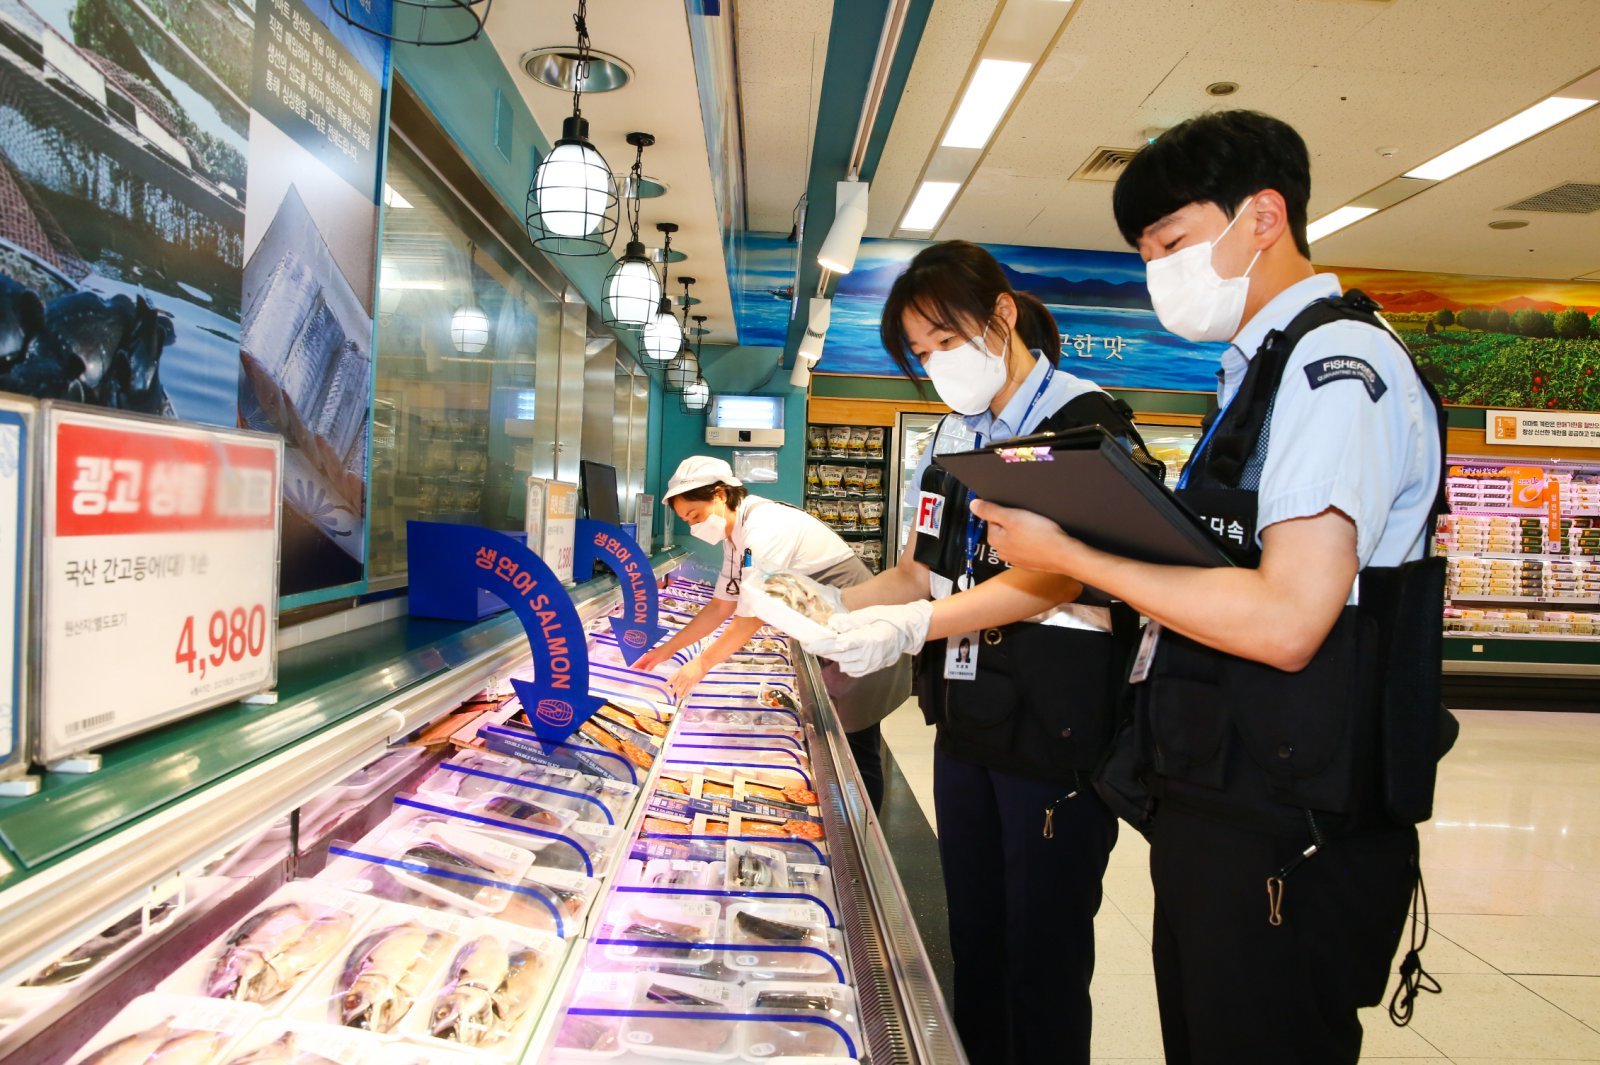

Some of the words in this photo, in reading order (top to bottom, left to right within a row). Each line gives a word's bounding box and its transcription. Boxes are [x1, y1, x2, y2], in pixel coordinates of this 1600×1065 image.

[269, 14, 283, 43] 직접
[285, 31, 310, 69] 매입하여
[311, 57, 324, 81] 냉장
[272, 0, 290, 20] 마트
[292, 10, 311, 42] 생선은
[312, 31, 325, 56] 매일
[325, 45, 337, 69] 아침
[338, 59, 359, 89] 산지에서
[266, 69, 281, 98] 통해
[282, 85, 307, 121] 싱싱함을
[308, 109, 326, 135] 그대로
[267, 42, 287, 75] 생선의
[288, 62, 306, 93] 선도를
[307, 80, 325, 109] 해치지
[325, 97, 336, 119] 않는
[337, 107, 351, 133] 특별한
[1103, 336, 1127, 360] 맛
[72, 455, 142, 515] 광고
[65, 559, 97, 587] 국산
[594, 532, 631, 564] 생연어
[625, 563, 648, 624] SALMON
[175, 604, 265, 680] 4,980
[475, 546, 538, 596] 생연어
[530, 594, 571, 689] SALMON
